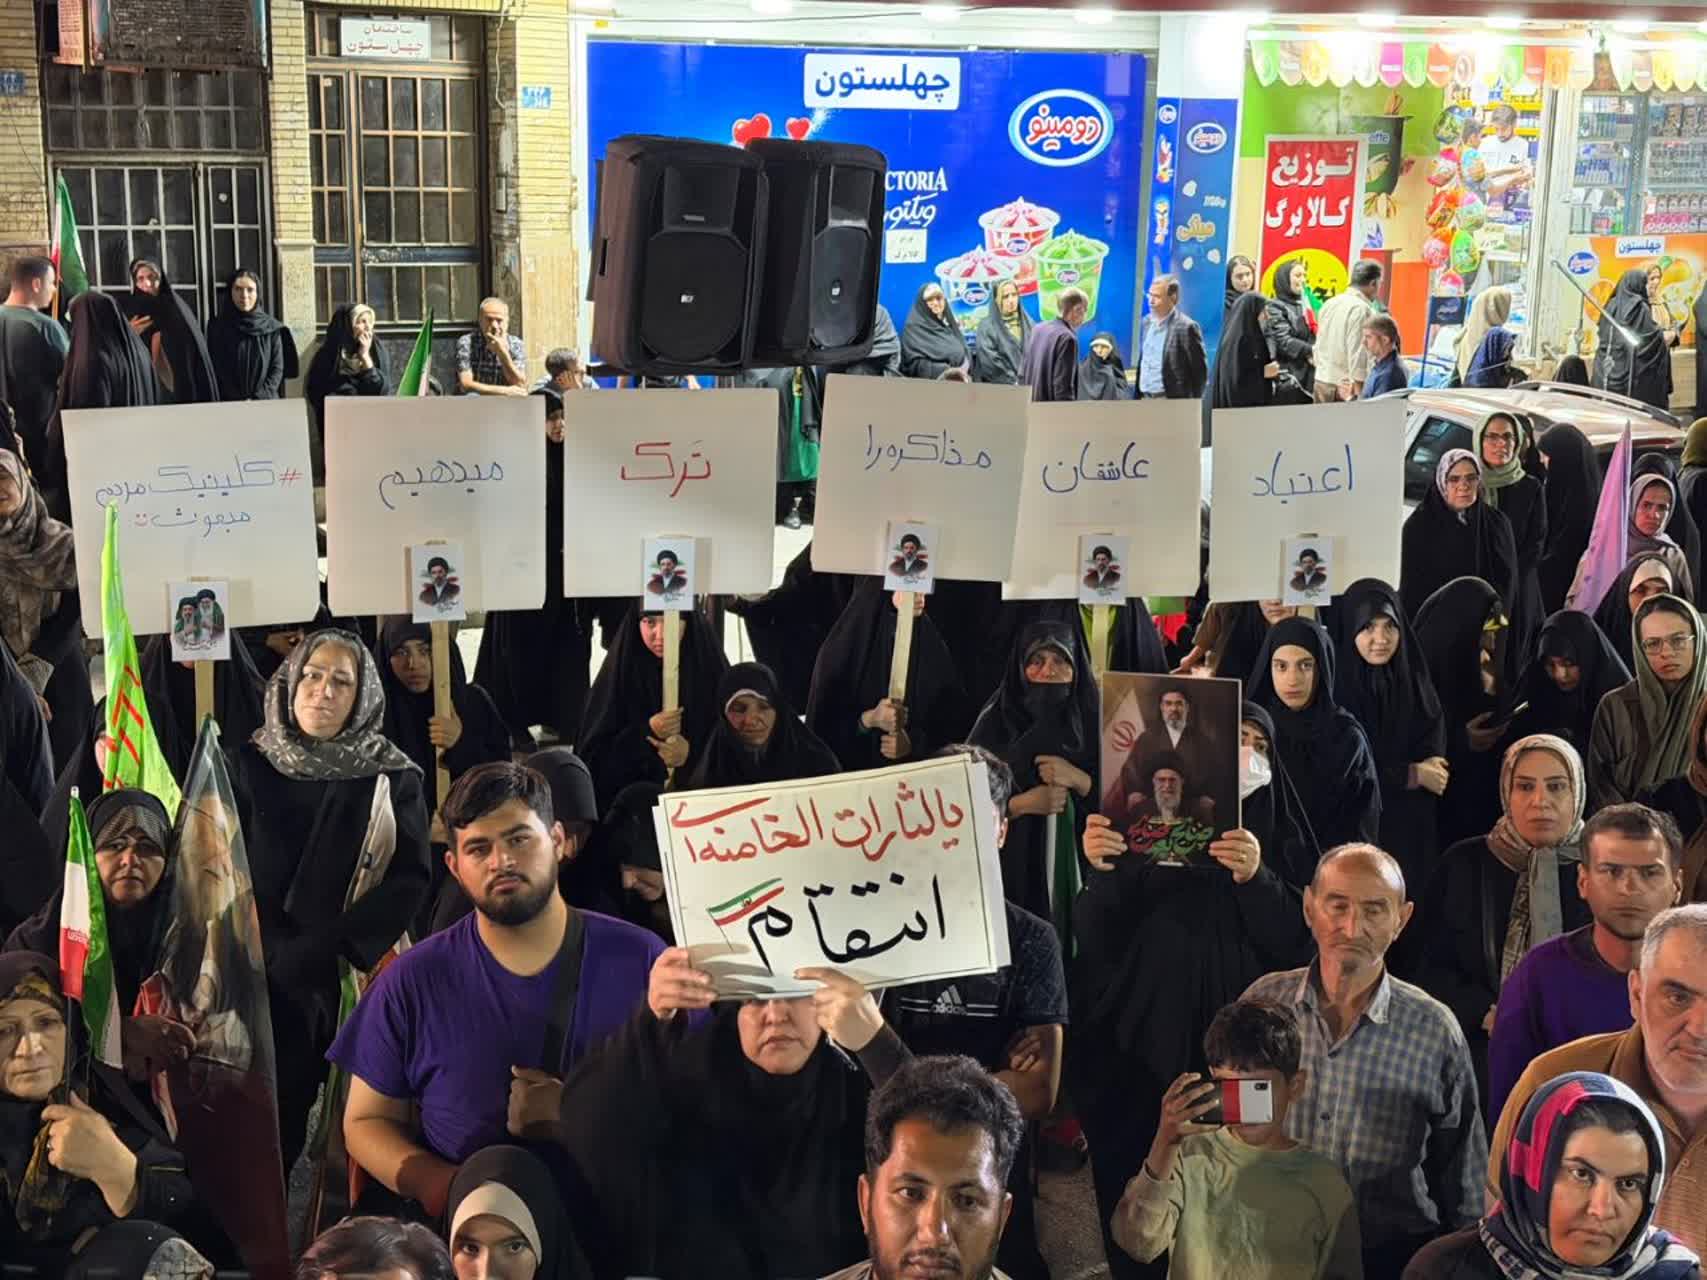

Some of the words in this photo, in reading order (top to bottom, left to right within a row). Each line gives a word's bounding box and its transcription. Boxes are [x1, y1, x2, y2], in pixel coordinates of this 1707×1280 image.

[814, 63, 951, 103] چهلستون
[1025, 104, 1101, 151] دومینو
[885, 167, 948, 191] CTORIA
[1271, 147, 1354, 187] توزیع
[378, 459, 504, 510] میدهیم
[1042, 441, 1150, 493] عاشقان
[1251, 443, 1354, 504] اعتیاد
[747, 872, 947, 978] انتقام
